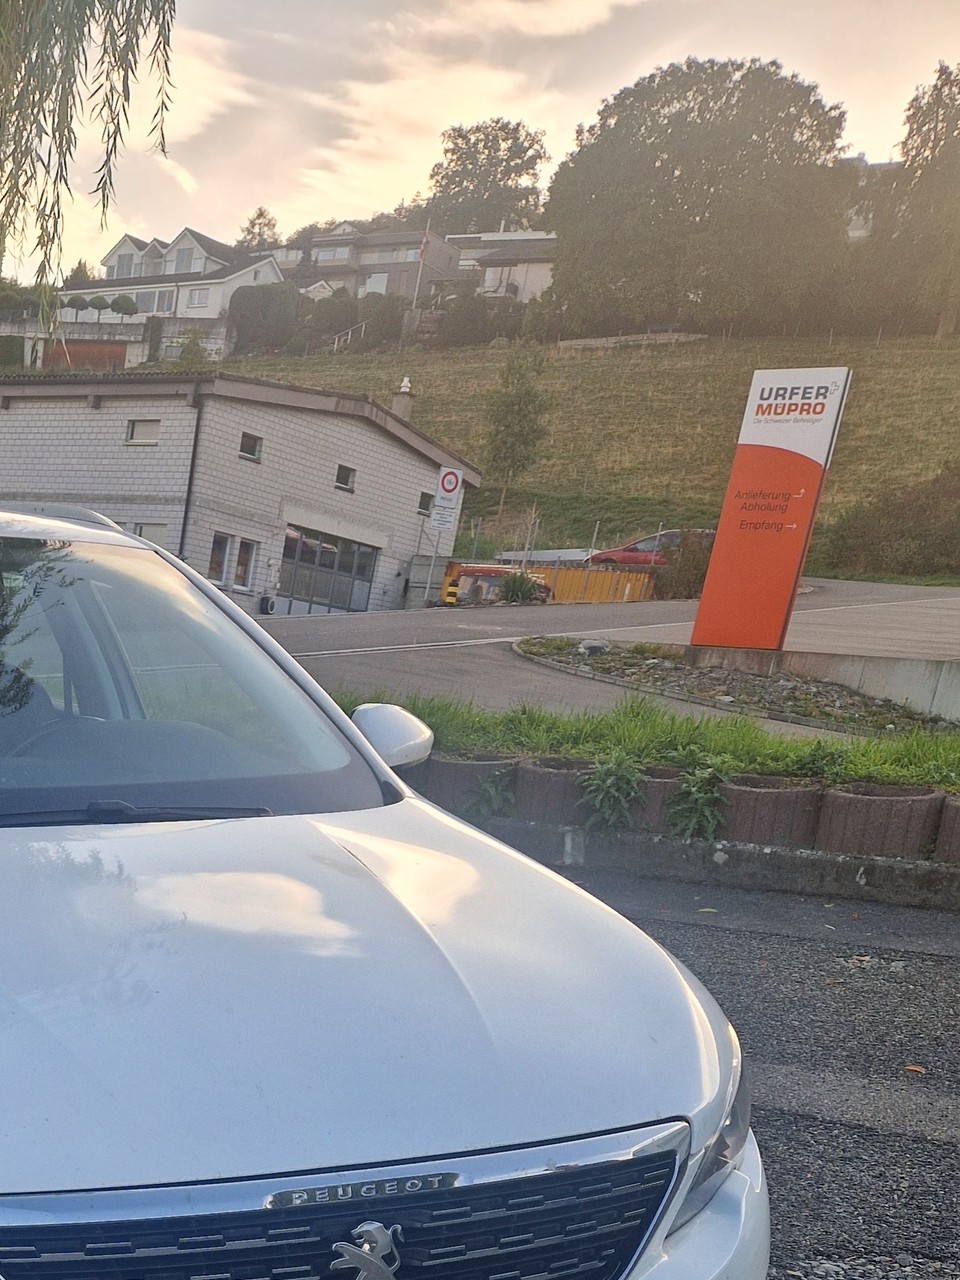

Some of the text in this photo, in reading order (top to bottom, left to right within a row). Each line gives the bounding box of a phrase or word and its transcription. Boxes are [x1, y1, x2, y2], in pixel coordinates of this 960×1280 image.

[759, 386, 829, 400] URFER
[755, 402, 826, 416] MÜPRO
[734, 490, 791, 502] Anlieferung
[740, 502, 788, 513] Abholung
[740, 520, 784, 532] Empfang
[292, 1176, 442, 1205] PEUGEOT
